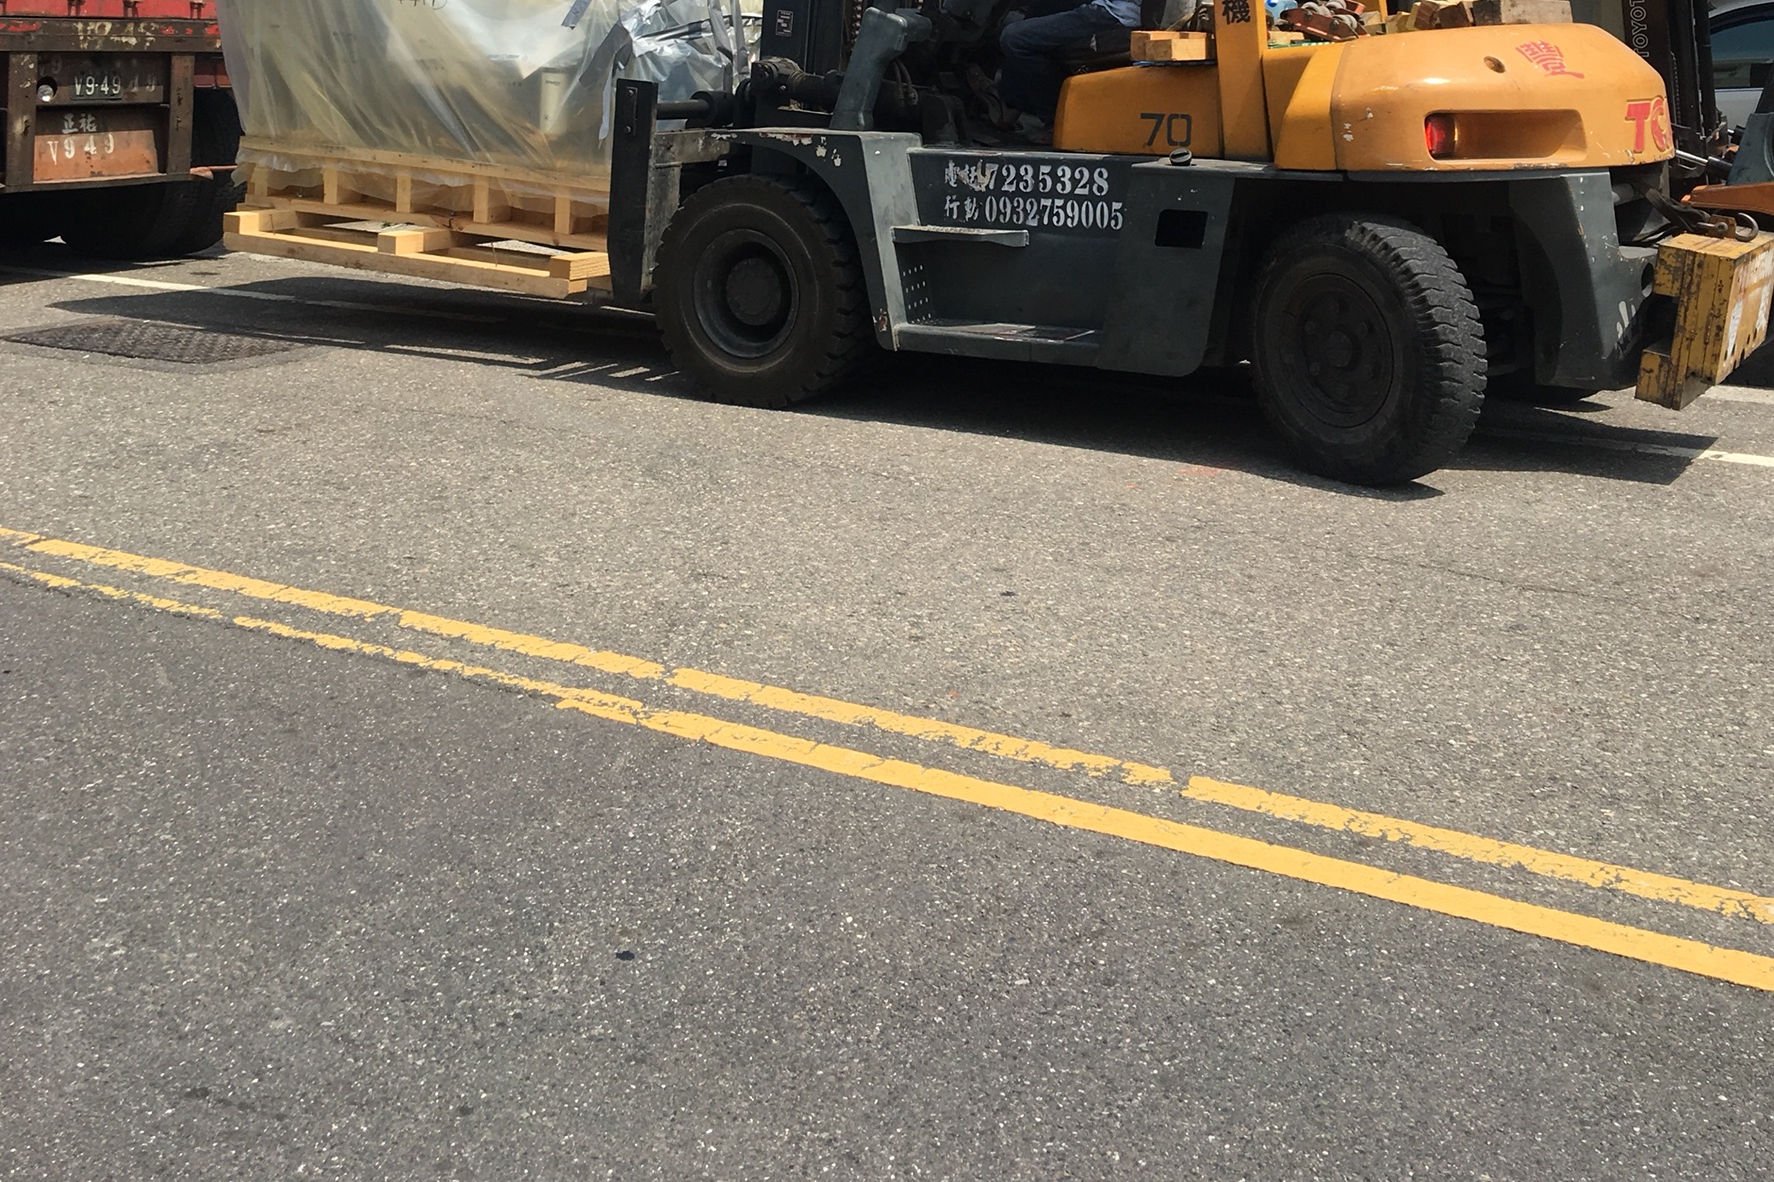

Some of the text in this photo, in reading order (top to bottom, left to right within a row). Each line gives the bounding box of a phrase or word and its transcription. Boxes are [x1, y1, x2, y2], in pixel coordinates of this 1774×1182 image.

[74, 75, 121, 96] V9-49
[1140, 113, 1192, 147] 70
[1625, 96, 1674, 154] TC
[985, 163, 1109, 196] 7235328
[985, 195, 1124, 231] 0932759005
